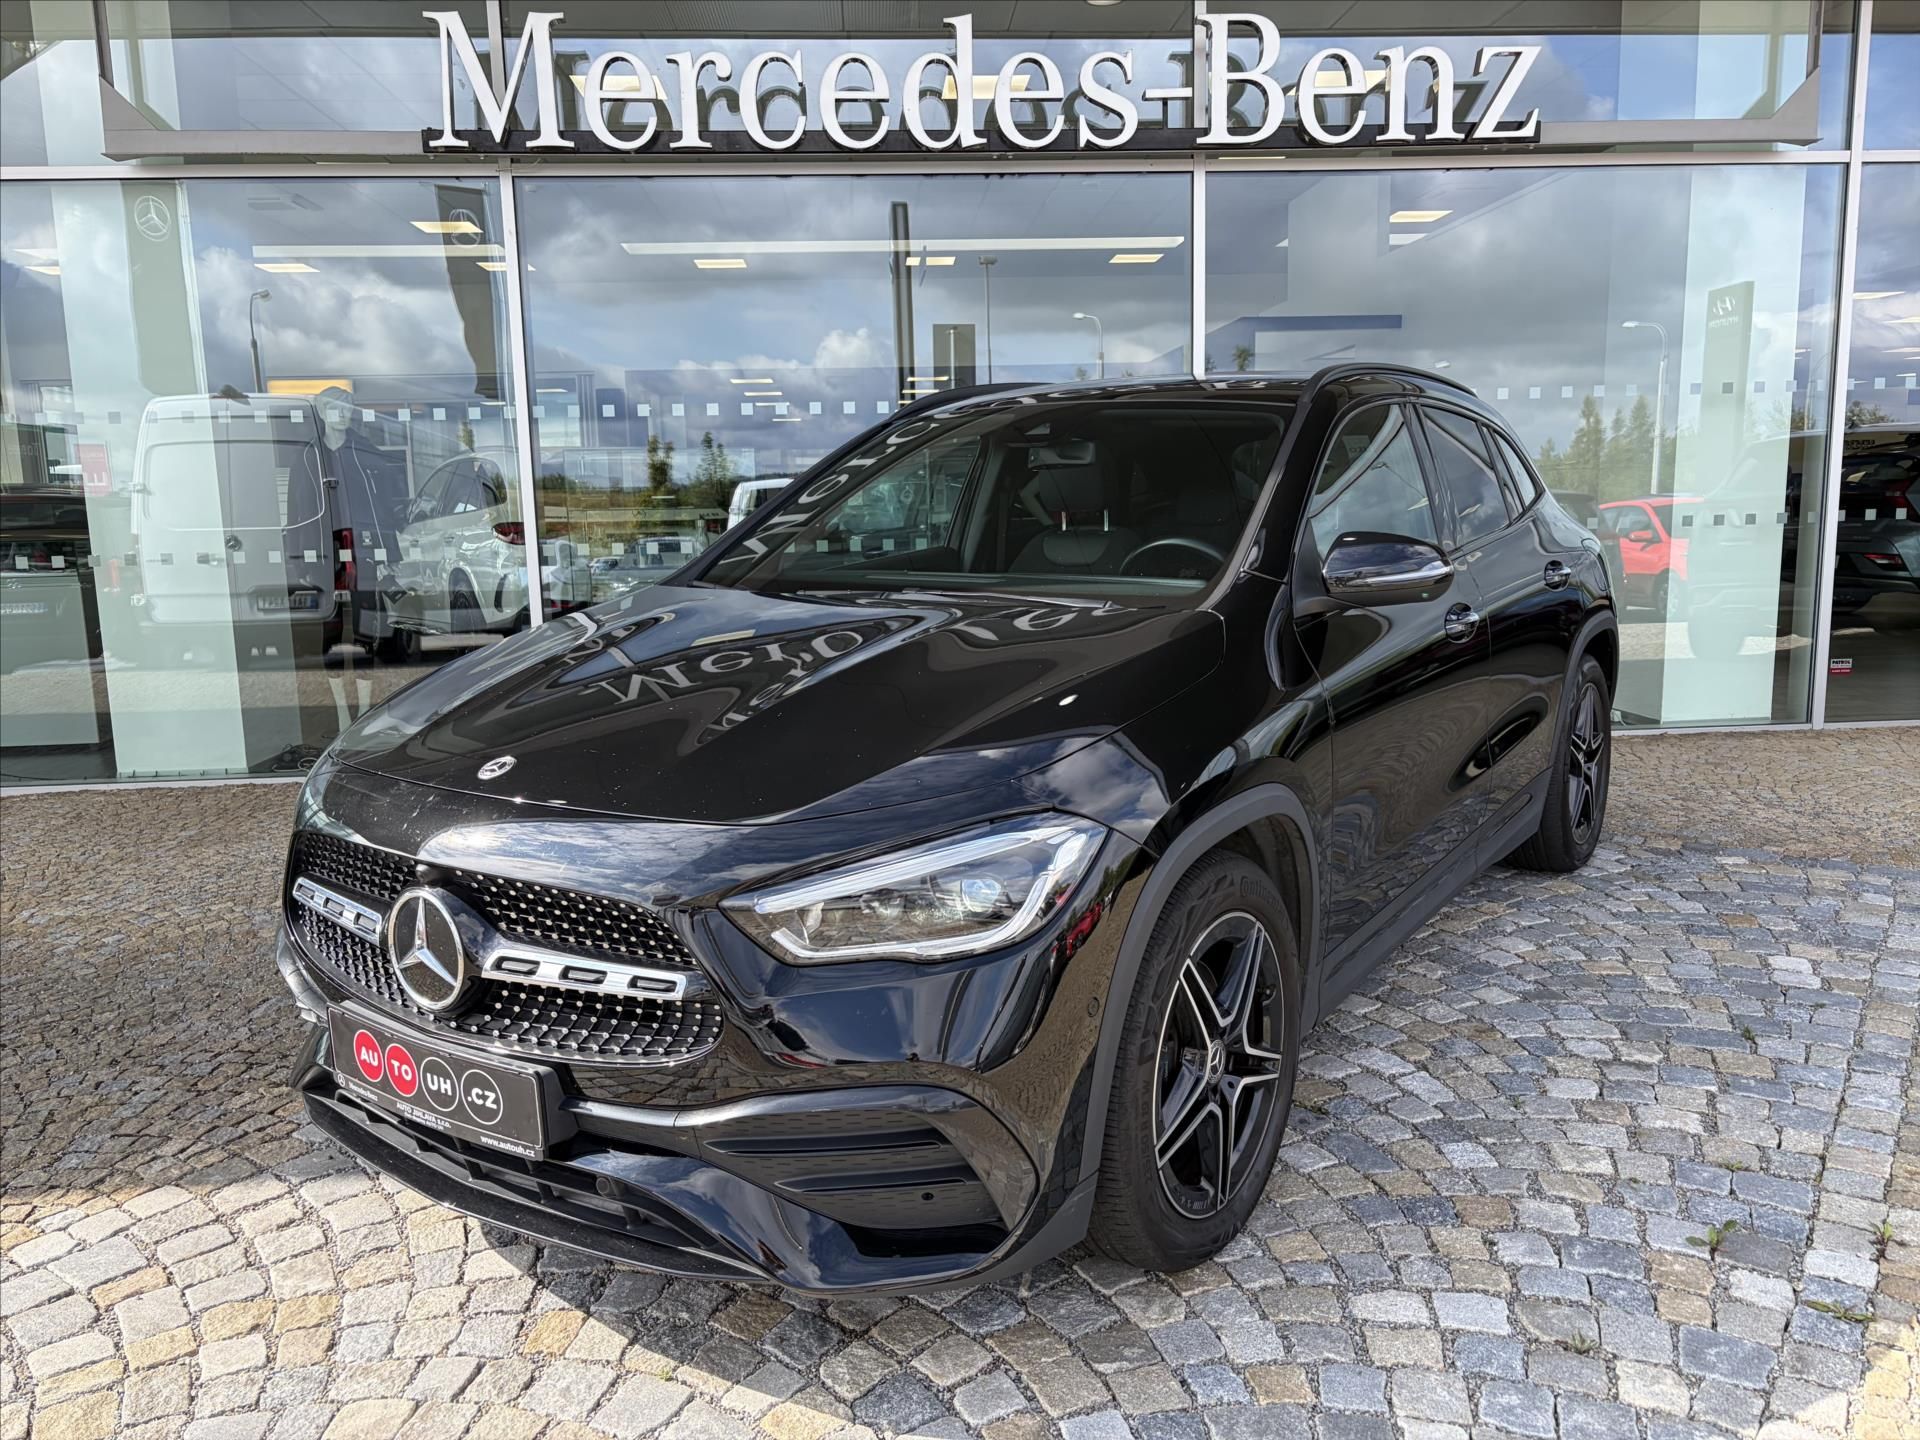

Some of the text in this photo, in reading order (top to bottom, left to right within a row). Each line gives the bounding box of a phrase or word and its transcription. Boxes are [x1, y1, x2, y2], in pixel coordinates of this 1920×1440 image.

[422, 11, 1542, 151] Mercedes-Benz
[426, 1073, 453, 1097] UH
[467, 1088, 497, 1110] .CZ
[480, 1135, 536, 1158] www.autouh.cz
